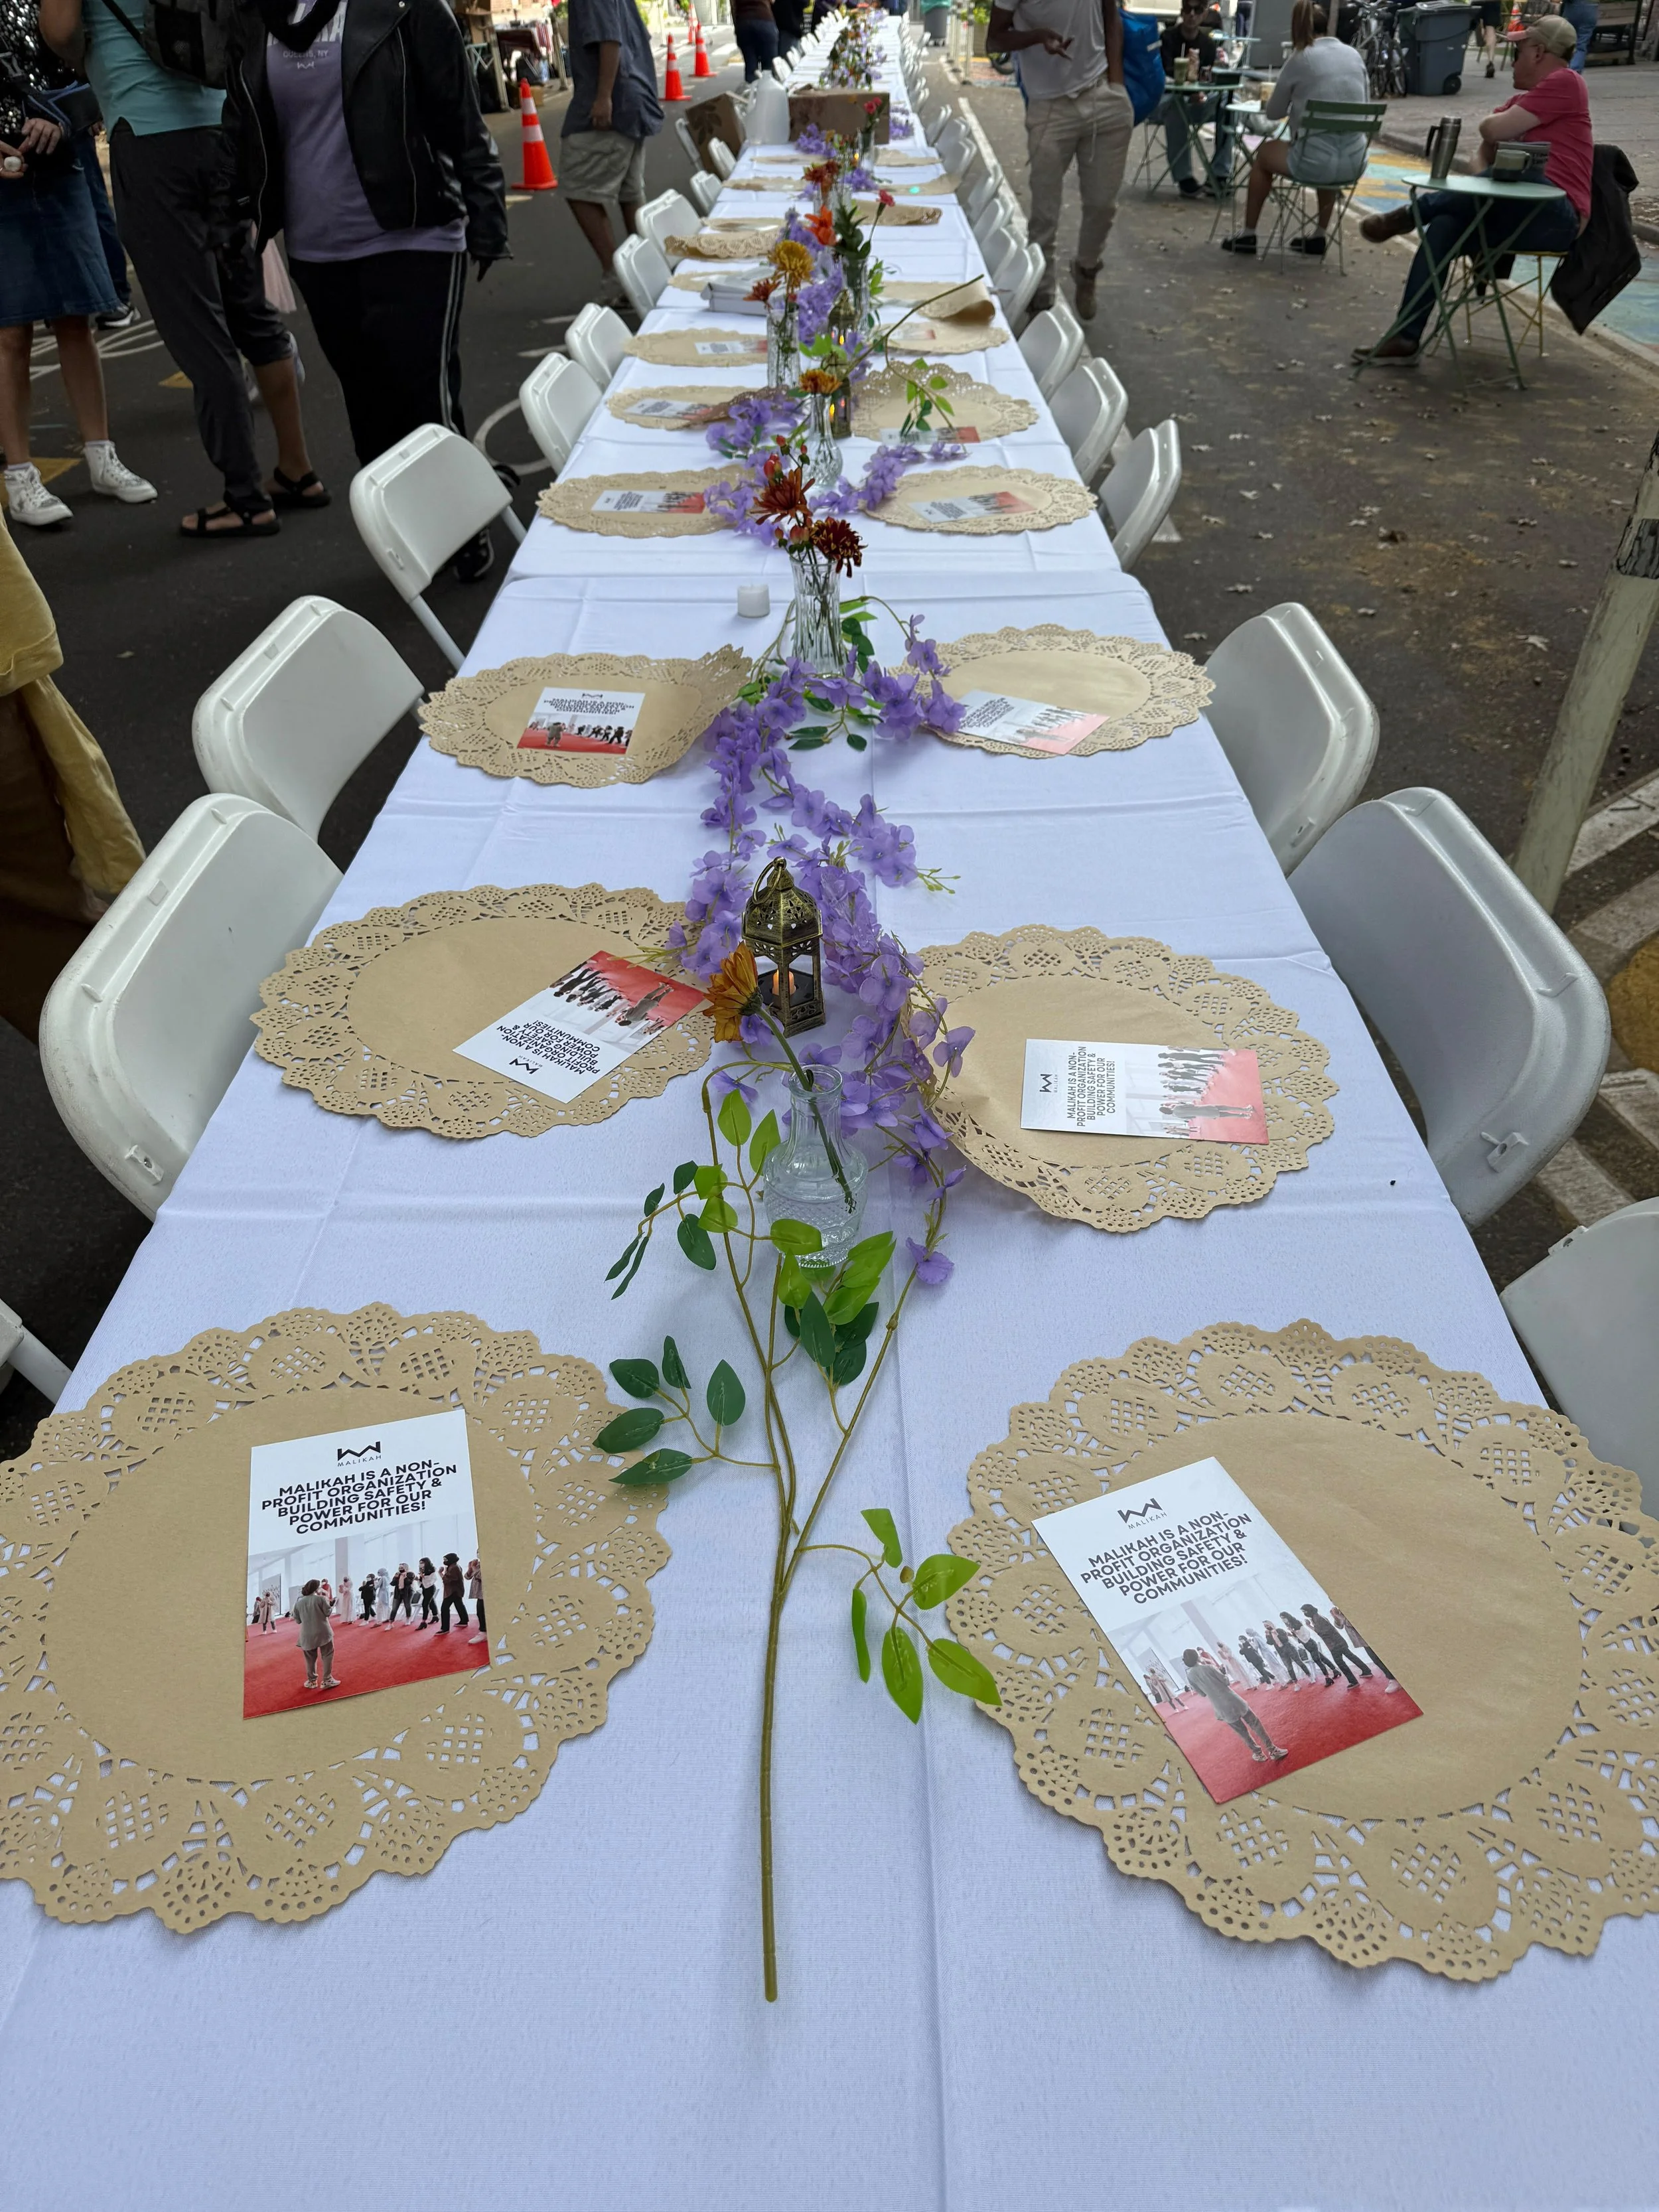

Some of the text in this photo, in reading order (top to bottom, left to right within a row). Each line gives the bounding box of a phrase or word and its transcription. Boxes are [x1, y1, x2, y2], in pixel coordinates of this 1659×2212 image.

[496, 1025, 601, 1074] PROFIT ORGANIZATION
[501, 1034, 525, 1047] NON-
[518, 1029, 554, 1046] SAFETY
[523, 1023, 599, 1058] POWER FOR OUR
[532, 1019, 601, 1052] COMMUNITIES!
[542, 1053, 585, 1074] MALIKAH
[553, 1043, 599, 1065] BUILDING
[1087, 1059, 1096, 1084] SAFETY
[1067, 1086, 1076, 1118] MALIKAH
[1077, 1047, 1086, 1127] PROFIT ORGANIZATION
[1087, 1086, 1096, 1120] BUILDING
[1097, 1057, 1106, 1116] POWER FOR OUR
[1106, 1061, 1116, 1114] COMMUNITIES!
[279, 1459, 440, 1497] MALIKAH IS A NON-
[337, 1455, 382, 1467] MALIKAH
[262, 1464, 457, 1510] PROFIT ORGANIZATION
[278, 1477, 443, 1517] BUILDING SAFETY &
[289, 1489, 432, 1525] POWER FOR OUR
[296, 1501, 426, 1534] COMMUNITIES!
[1128, 1512, 1168, 1530] MALIKAH
[1080, 1513, 1252, 1584] PROFIT ORGANIZATION
[1088, 1511, 1229, 1568] MALIKAH IS A NON-
[1102, 1529, 1247, 1589] BUILDING SAFETY &
[1119, 1542, 1246, 1596] POWER FOR OUR
[1133, 1554, 1248, 1604] COMMUNITIES!
